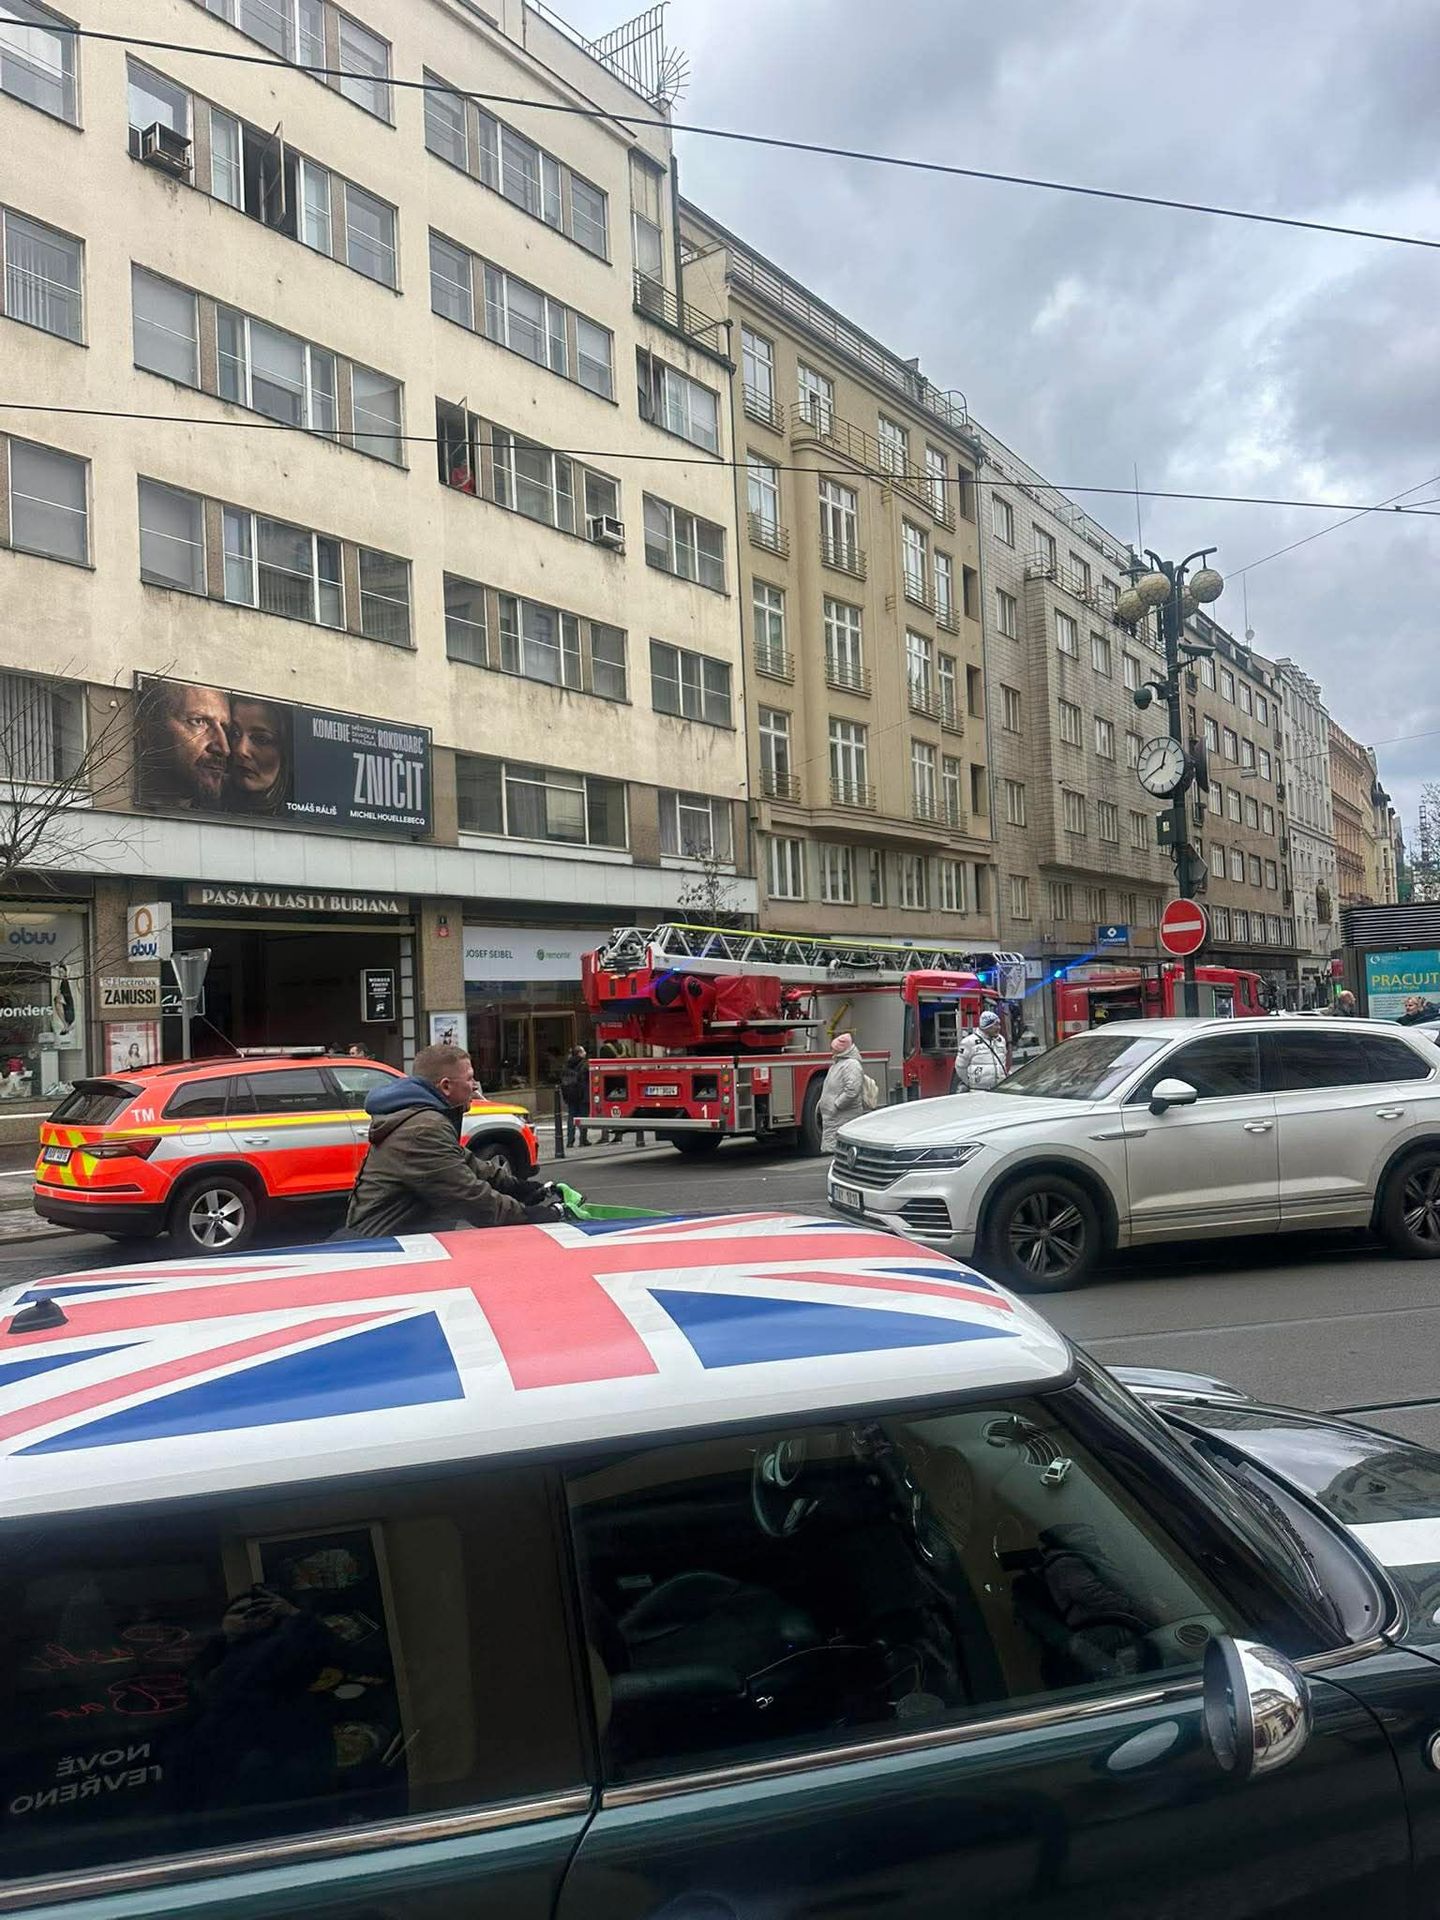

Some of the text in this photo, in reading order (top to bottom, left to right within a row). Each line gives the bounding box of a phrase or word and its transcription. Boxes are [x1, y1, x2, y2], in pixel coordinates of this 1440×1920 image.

[312, 718, 350, 743] KOMEDIE
[353, 752, 424, 811] ZNIČIT
[286, 802, 338, 816] TOMÁŠ RÁLIŠ
[349, 810, 426, 826] MICHEL HOUELLEBECQ
[202, 887, 399, 913] PASÁŽ VLASTY BURIANA
[465, 949, 513, 960] JOSEF SEIBEL
[1371, 972, 1440, 987] PRACUJT
[104, 989, 157, 1005] ZANUSSI
[130, 1107, 155, 1122] TM
[701, 1104, 708, 1119] 1
